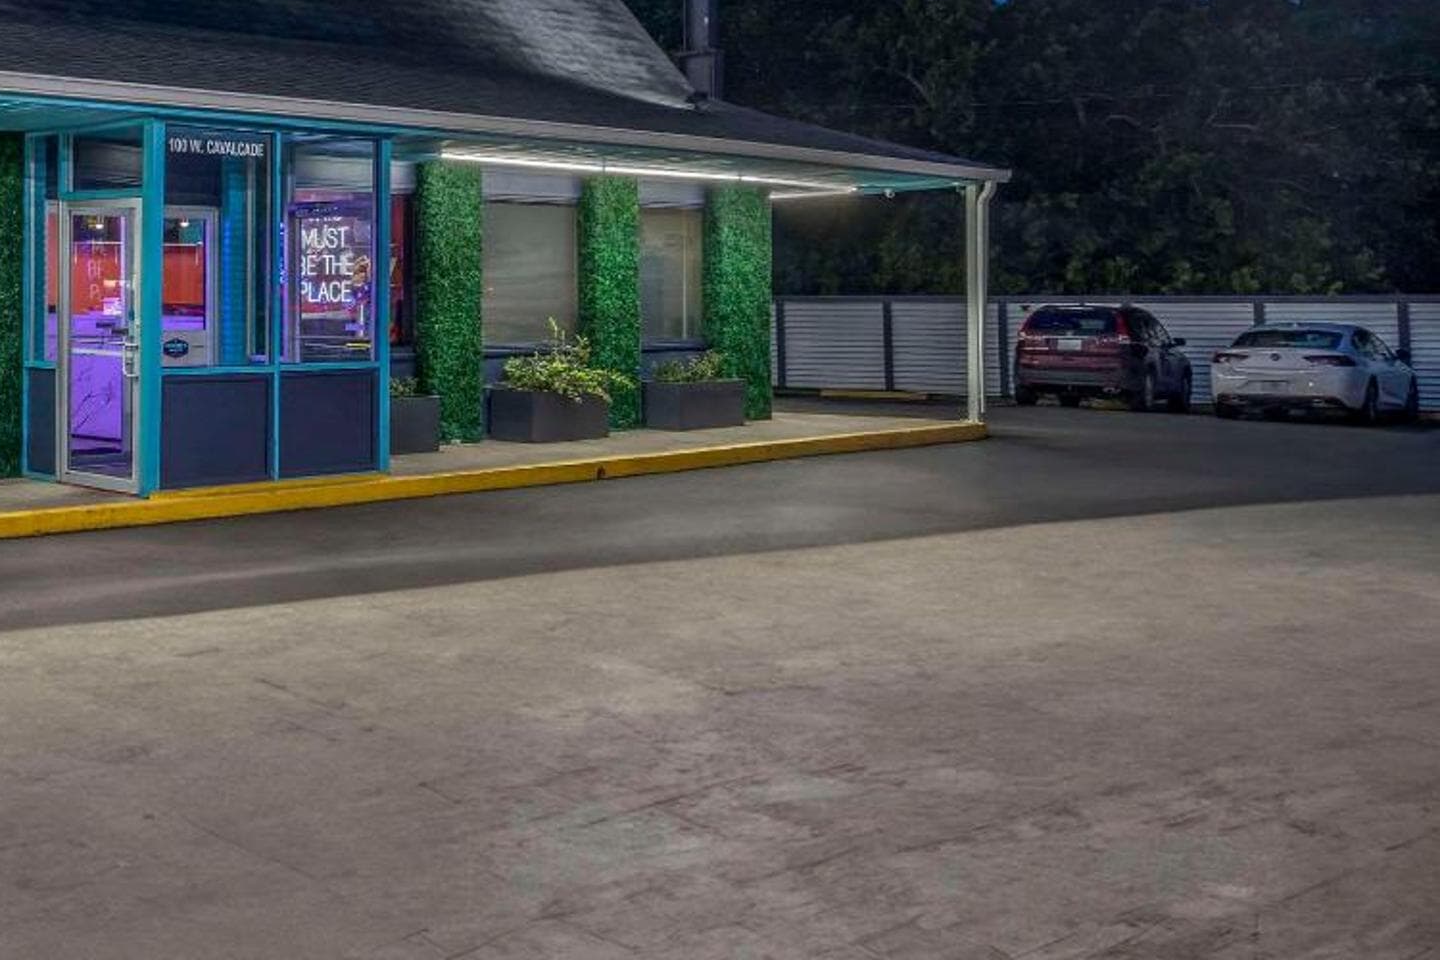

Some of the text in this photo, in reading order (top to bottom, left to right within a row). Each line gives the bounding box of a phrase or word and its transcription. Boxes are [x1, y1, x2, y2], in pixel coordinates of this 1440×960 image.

[169, 138, 188, 153] 100
[206, 139, 265, 156] CAVALCADE
[301, 224, 350, 250] MUST
[322, 252, 353, 275] THE
[300, 280, 352, 303] PLACE
